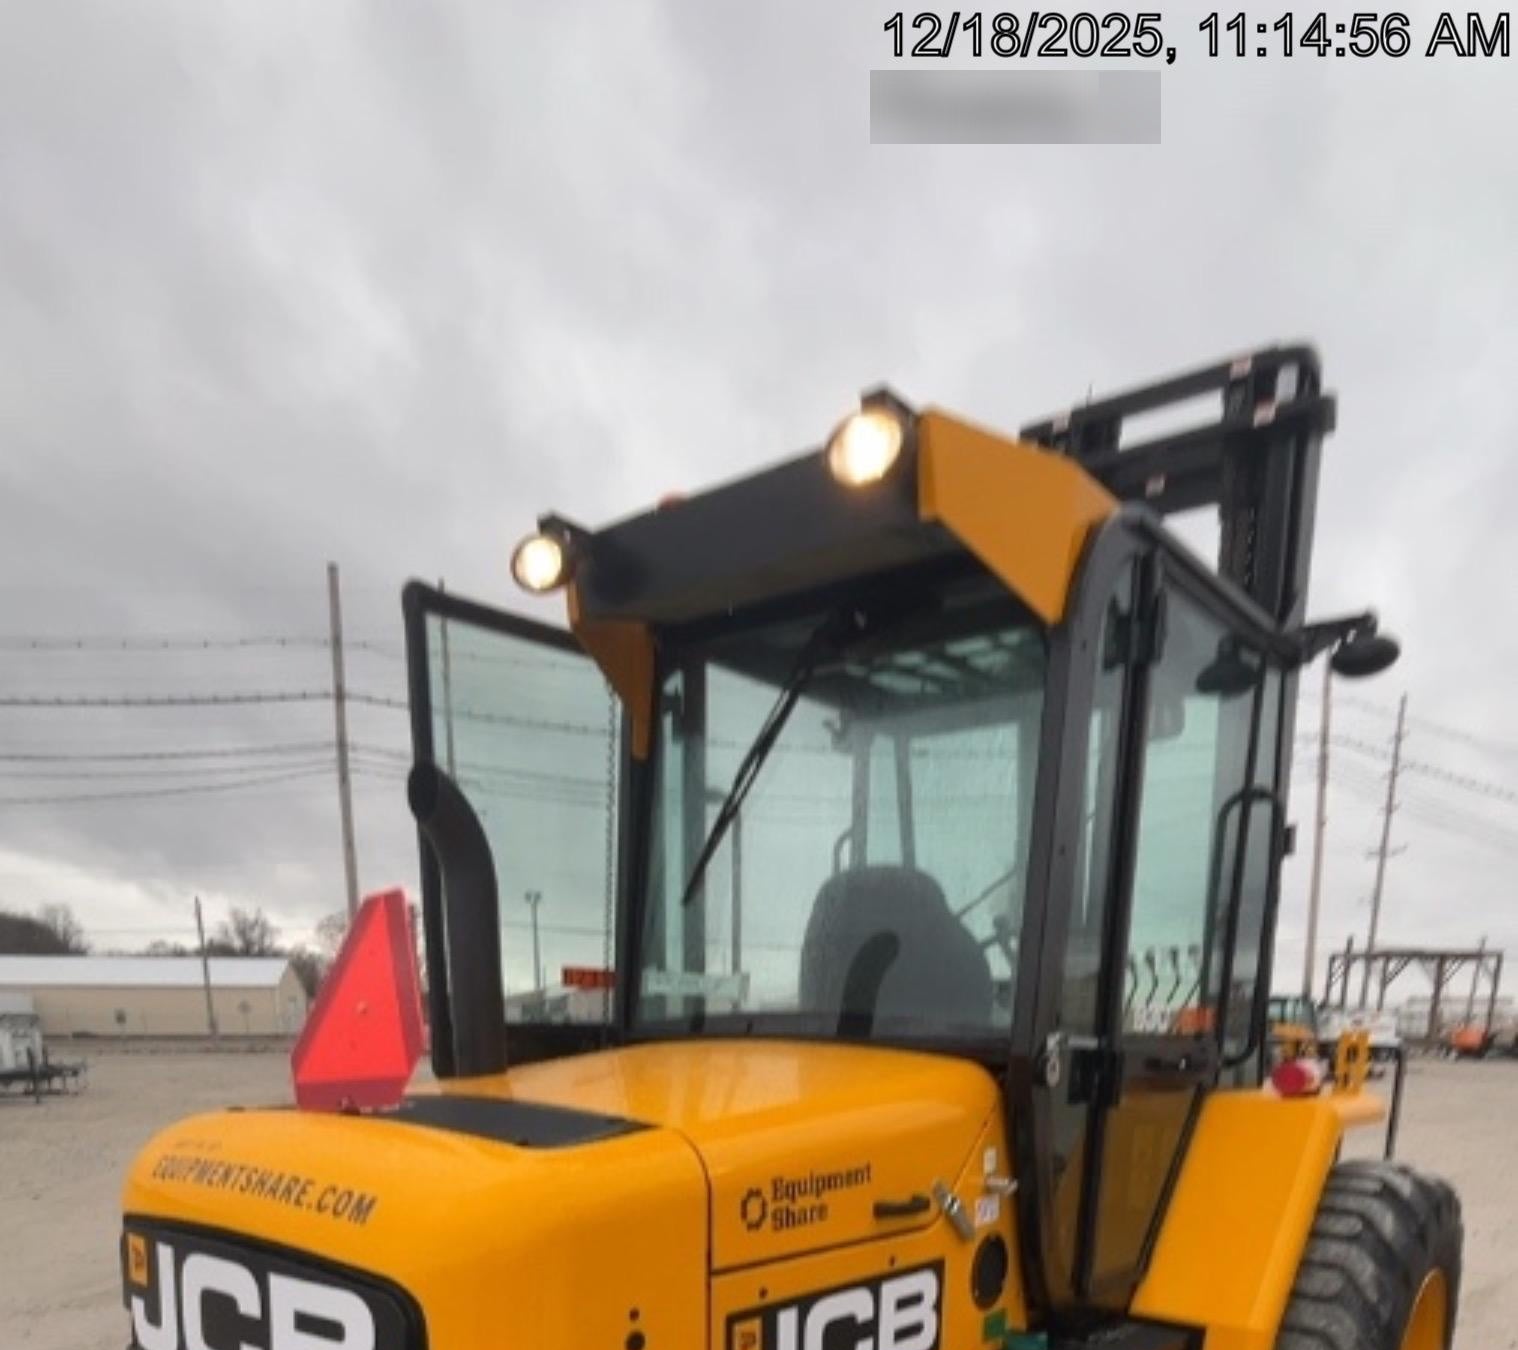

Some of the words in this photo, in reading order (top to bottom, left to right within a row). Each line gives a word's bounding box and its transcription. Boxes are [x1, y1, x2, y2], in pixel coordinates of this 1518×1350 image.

[153, 1154, 378, 1225] EQUIPMENTSHARE.COM
[771, 1162, 872, 1202] Equipment
[772, 1203, 828, 1232] Share
